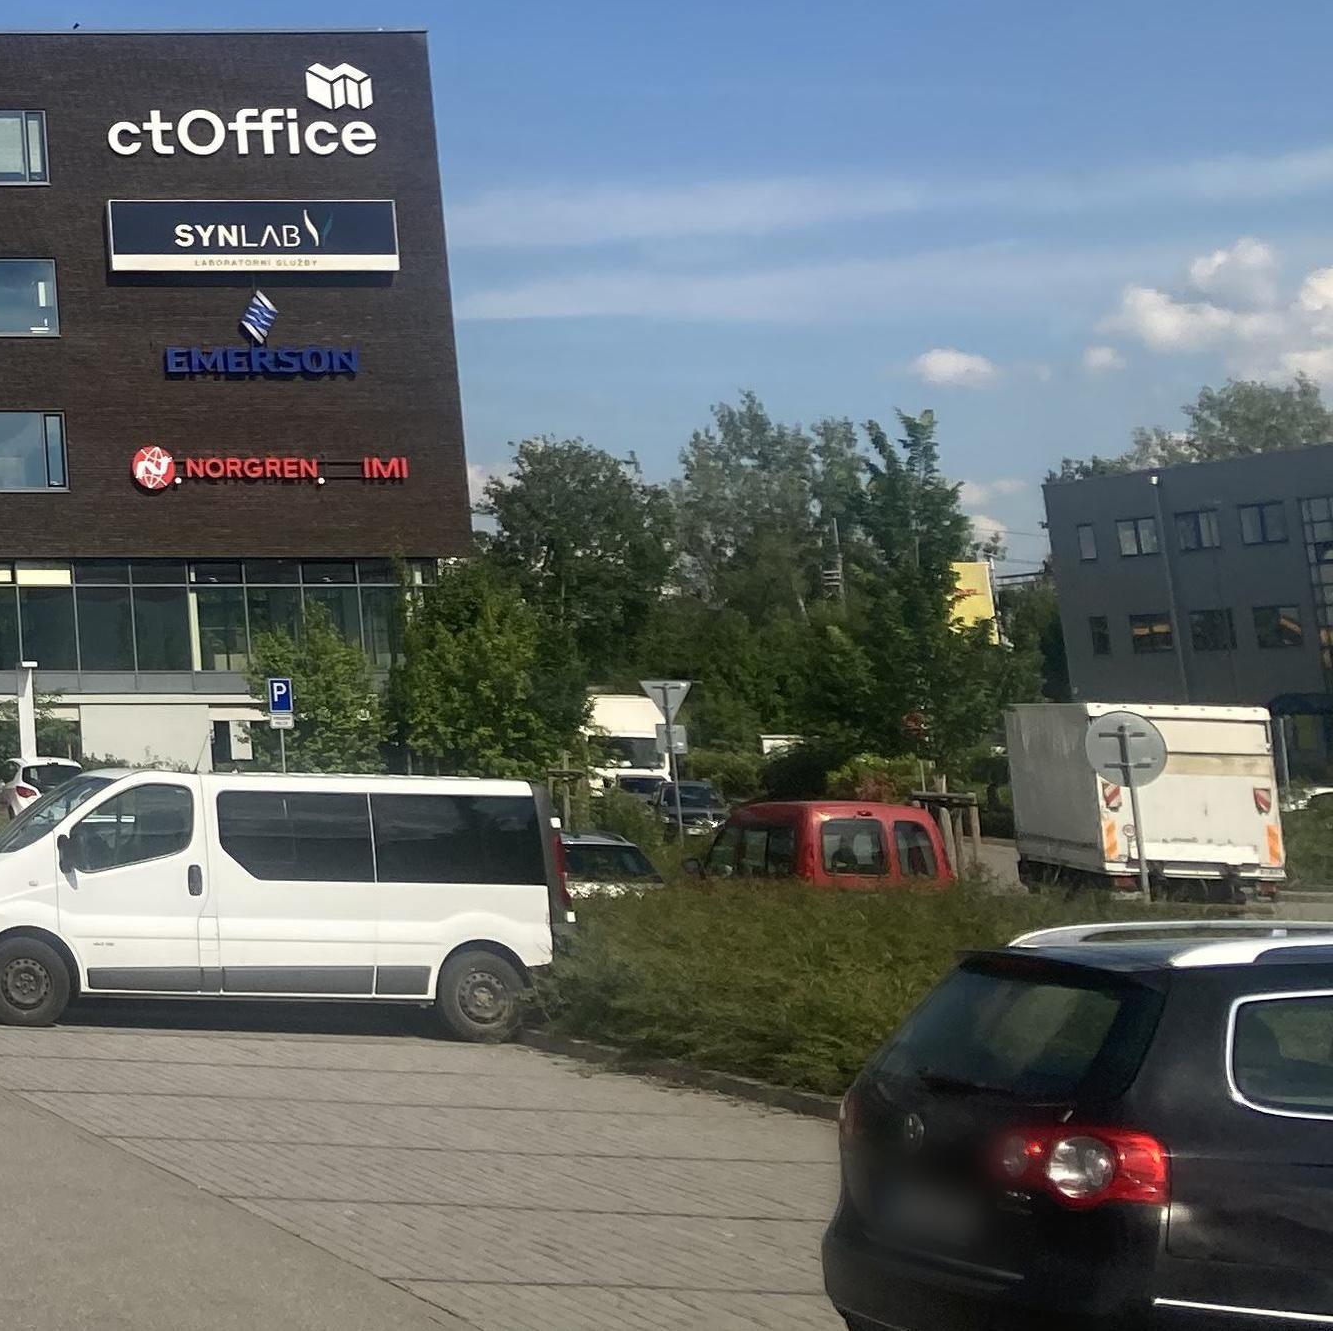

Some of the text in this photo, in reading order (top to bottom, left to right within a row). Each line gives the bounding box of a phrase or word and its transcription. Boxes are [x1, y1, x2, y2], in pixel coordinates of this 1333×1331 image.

[108, 108, 377, 155] ctOffice
[174, 225, 300, 247] SYNLAB
[167, 347, 358, 374] EMERSON
[186, 456, 410, 479] NORGREN IMI
